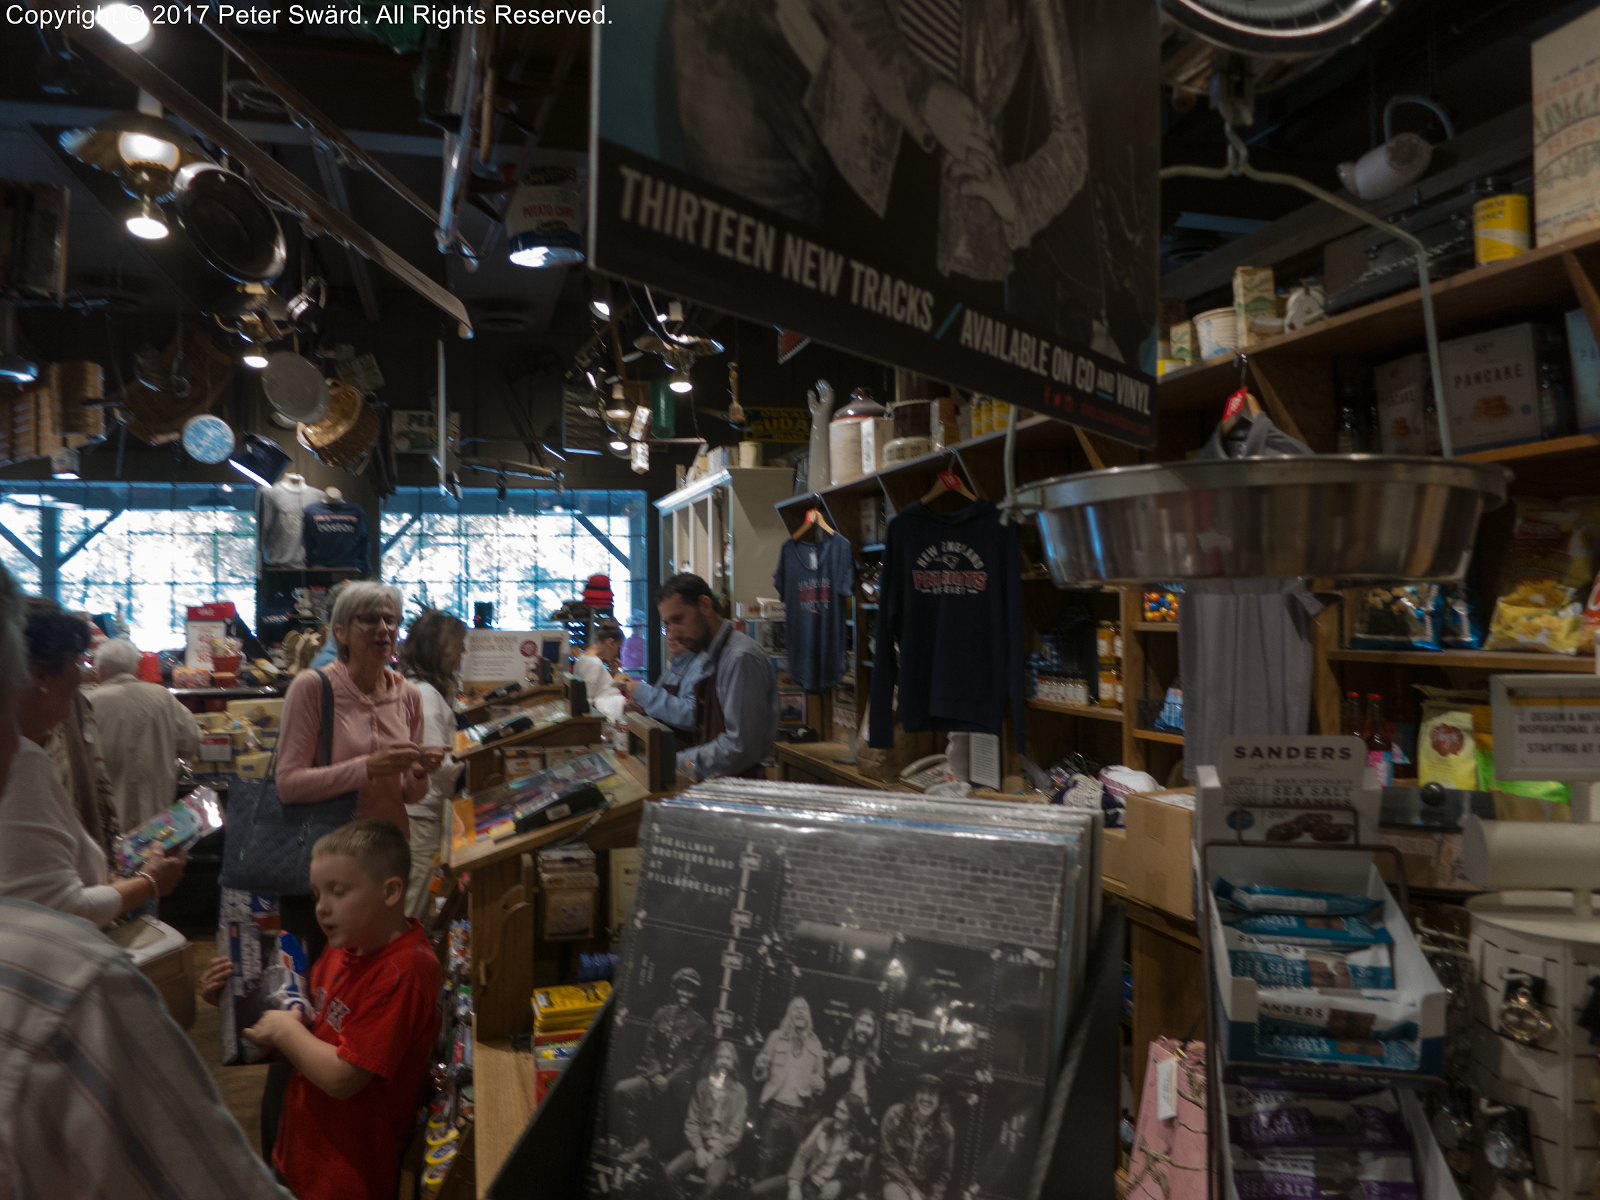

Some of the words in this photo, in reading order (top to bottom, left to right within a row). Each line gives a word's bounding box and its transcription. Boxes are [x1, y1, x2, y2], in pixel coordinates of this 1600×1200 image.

[619, 164, 777, 275] THIRTEEN
[781, 231, 845, 298] NEW
[849, 258, 935, 333] TRACKS
[959, 308, 1051, 378] AVAILABLE
[1051, 345, 1074, 386] ON
[1075, 356, 1095, 394] CD
[1096, 368, 1115, 394] AND
[1116, 371, 1152, 416] VINYL
[1454, 363, 1524, 390] PANCAKE
[915, 543, 940, 569] NEW
[940, 540, 986, 571] ENGLAND
[911, 569, 988, 592] PATRIOTS
[1530, 711, 1566, 722] DESIGN
[1518, 723, 1589, 735] INSPIRATIONAL
[1233, 745, 1352, 760] SANDERS
[1527, 742, 1578, 754] STARTING
[1581, 743, 1594, 753] AT
[1271, 786, 1304, 797] SEA
[1309, 786, 1354, 798] SALT
[1260, 1002, 1324, 1019] ANDERS
[1273, 1182, 1314, 1198] SALT
